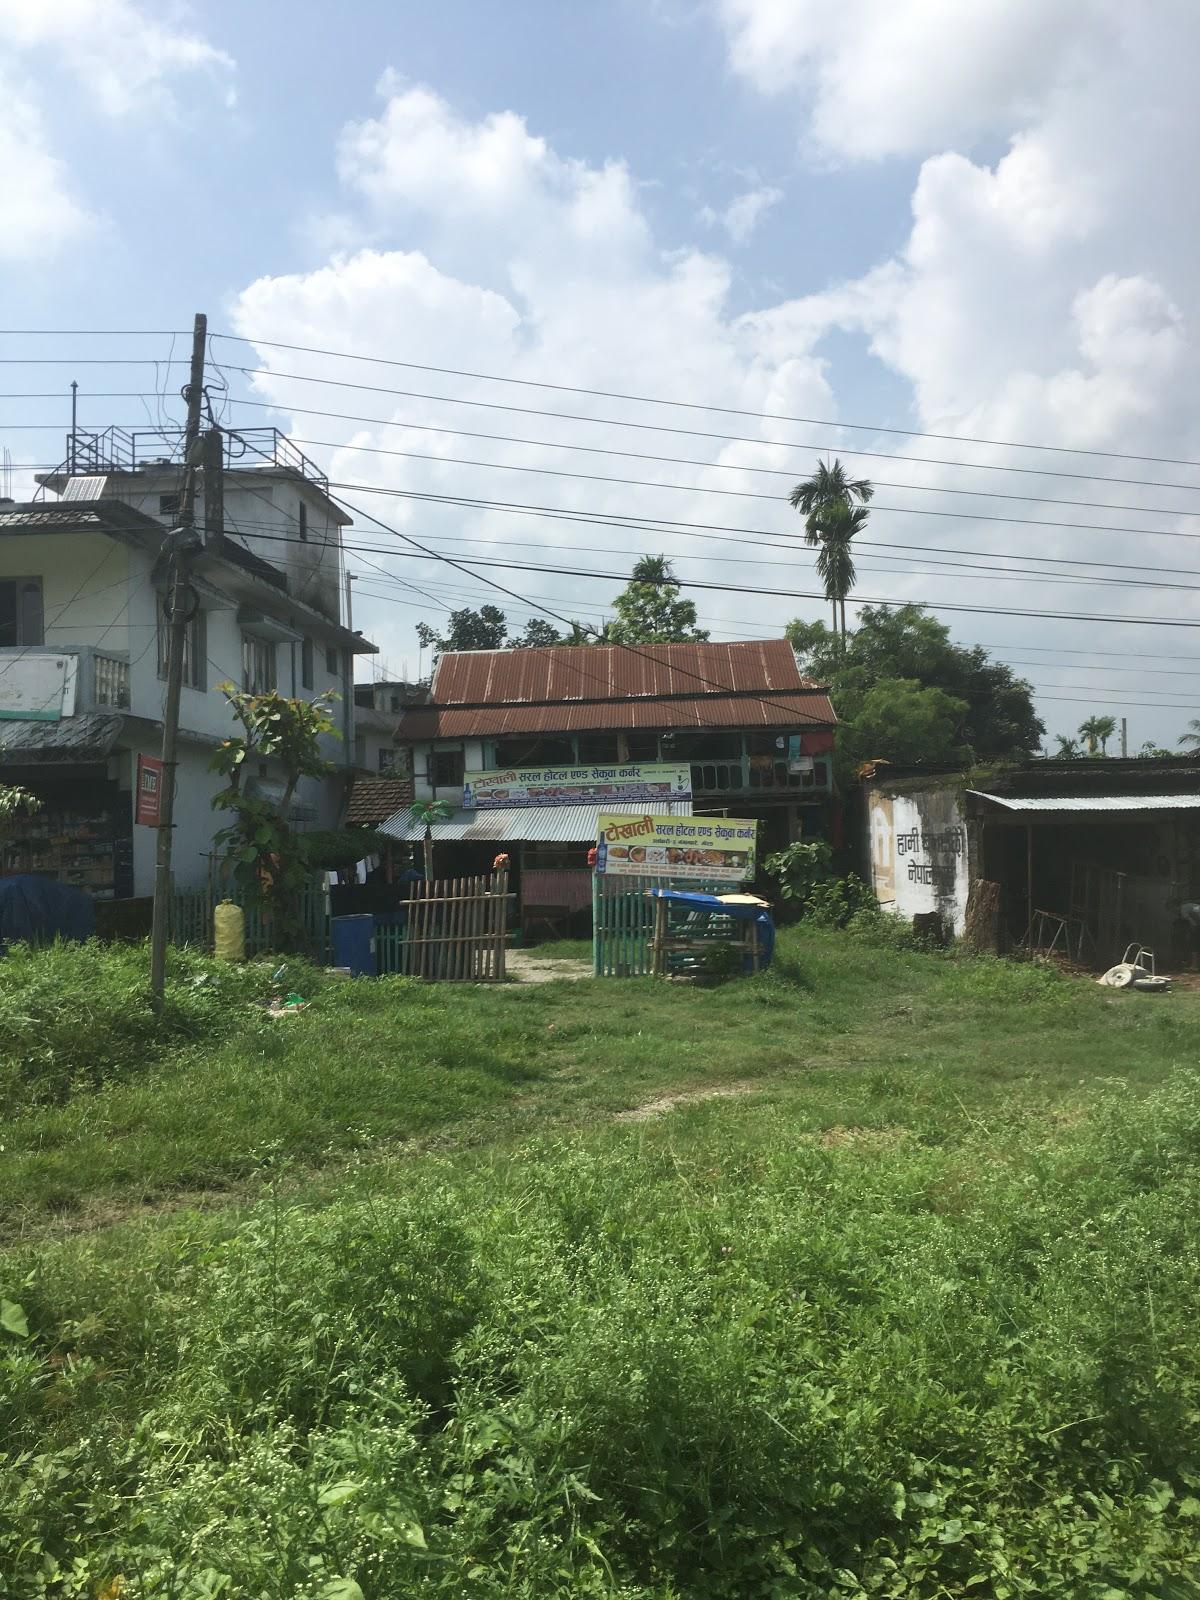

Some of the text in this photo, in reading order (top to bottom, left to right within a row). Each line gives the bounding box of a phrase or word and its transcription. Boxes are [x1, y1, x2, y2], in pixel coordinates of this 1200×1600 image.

[519, 771, 541, 783] सरल
[543, 768, 569, 781] होटल
[570, 769, 588, 780] एण्ड
[590, 767, 617, 781] सेकुवा
[618, 766, 642, 778] कर्नर
[655, 824, 675, 836] सरल
[675, 822, 696, 836] होटल
[697, 826, 713, 837] एण्ड
[714, 824, 736, 840] सेकुवा
[896, 827, 921, 856] हामी
